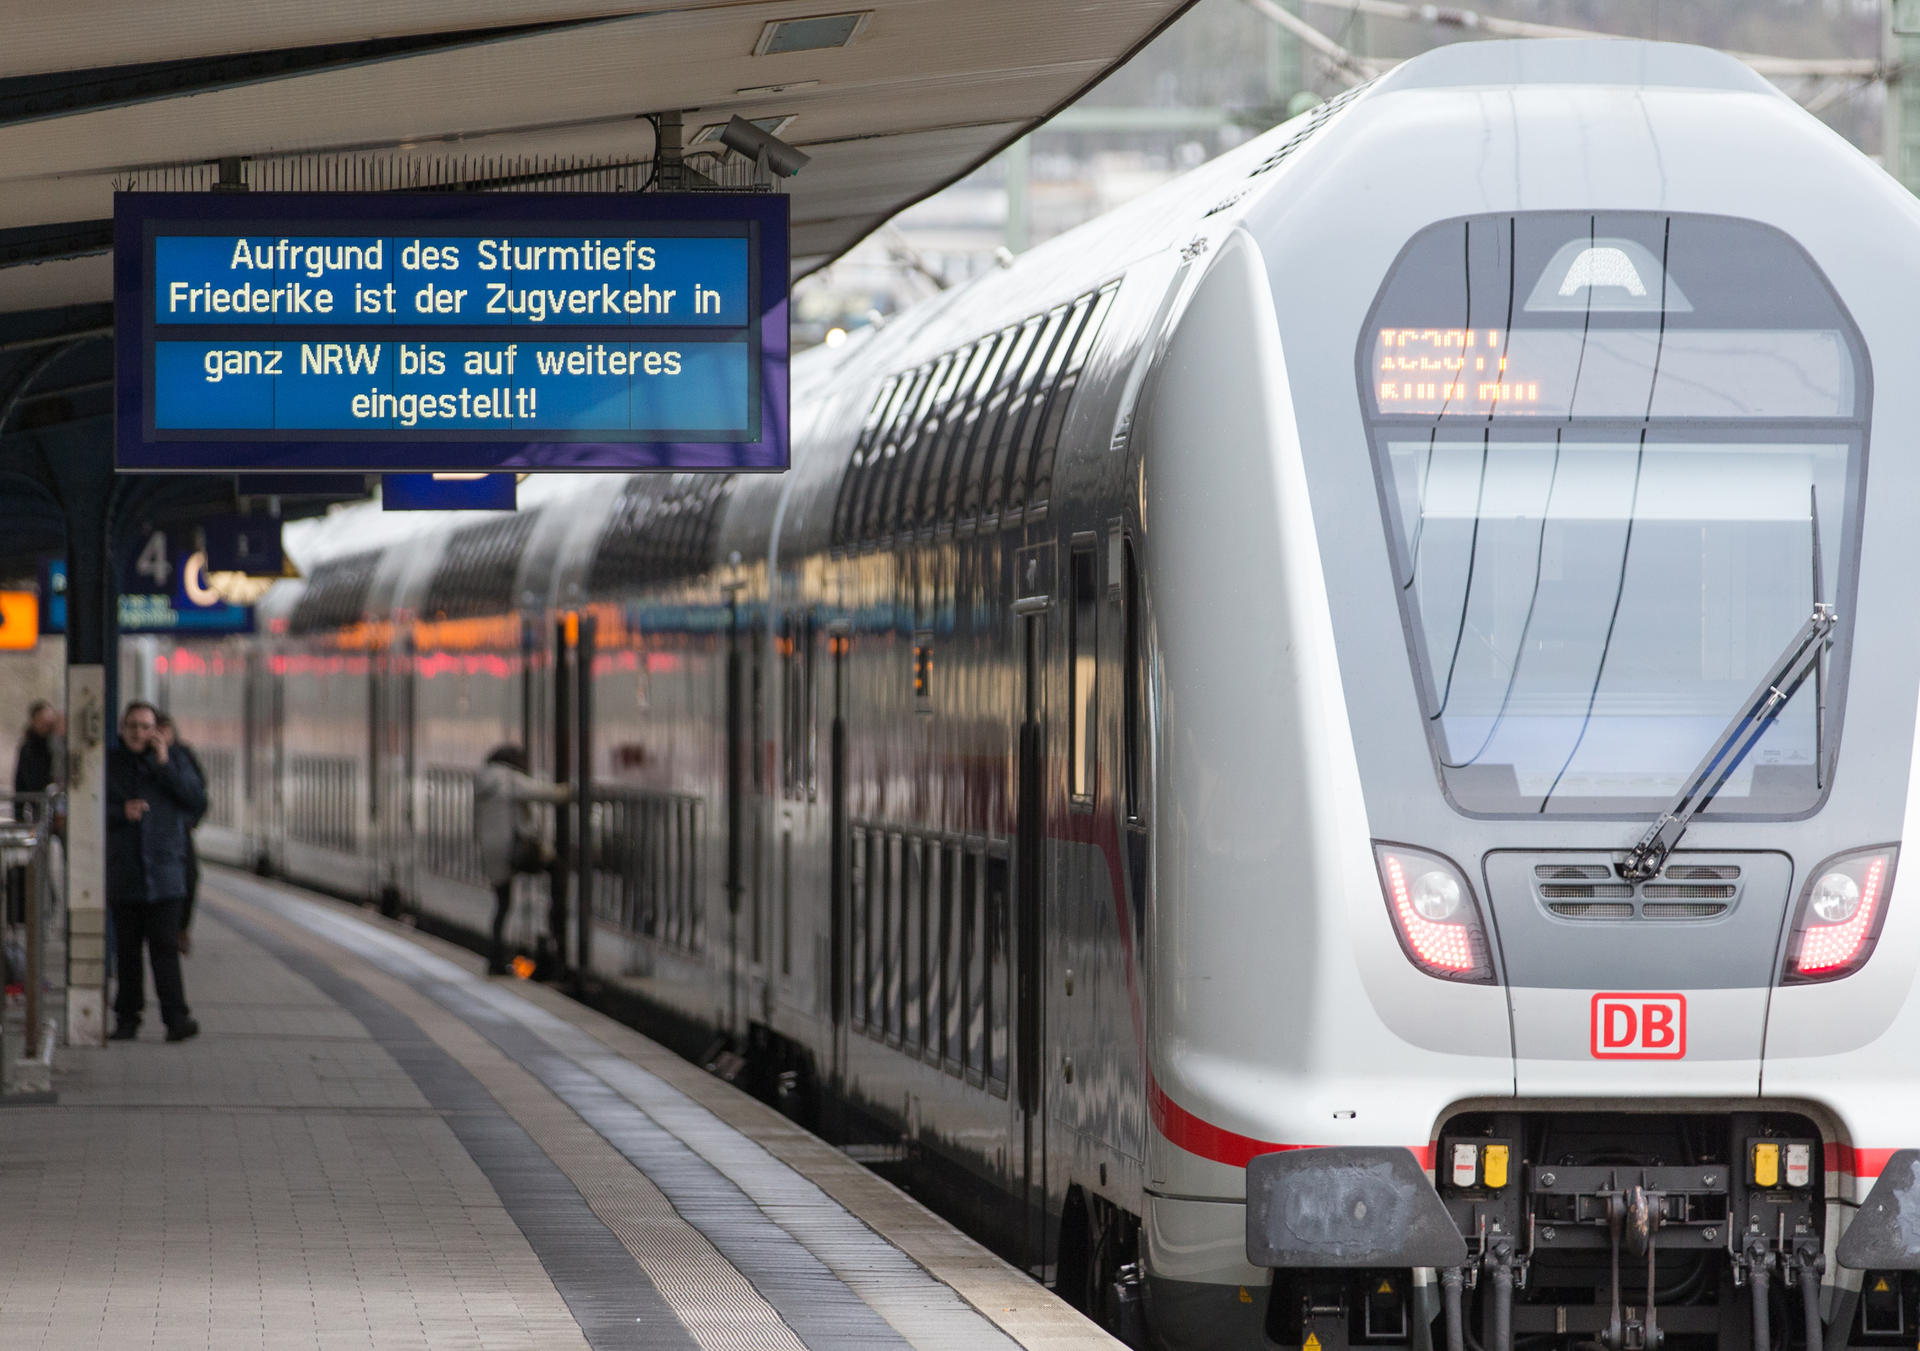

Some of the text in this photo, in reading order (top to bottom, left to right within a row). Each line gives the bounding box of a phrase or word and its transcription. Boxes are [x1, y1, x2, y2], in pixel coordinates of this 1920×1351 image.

[231, 239, 655, 277] Aufrgund des Sturmtiefs
[171, 282, 720, 321] Friederike ist der Zugverkehr in
[205, 344, 682, 382] ganz NRW bis auf weiteres
[352, 387, 537, 426] eingestellt!
[137, 530, 172, 587] 4
[1604, 1004, 1674, 1048] DB
